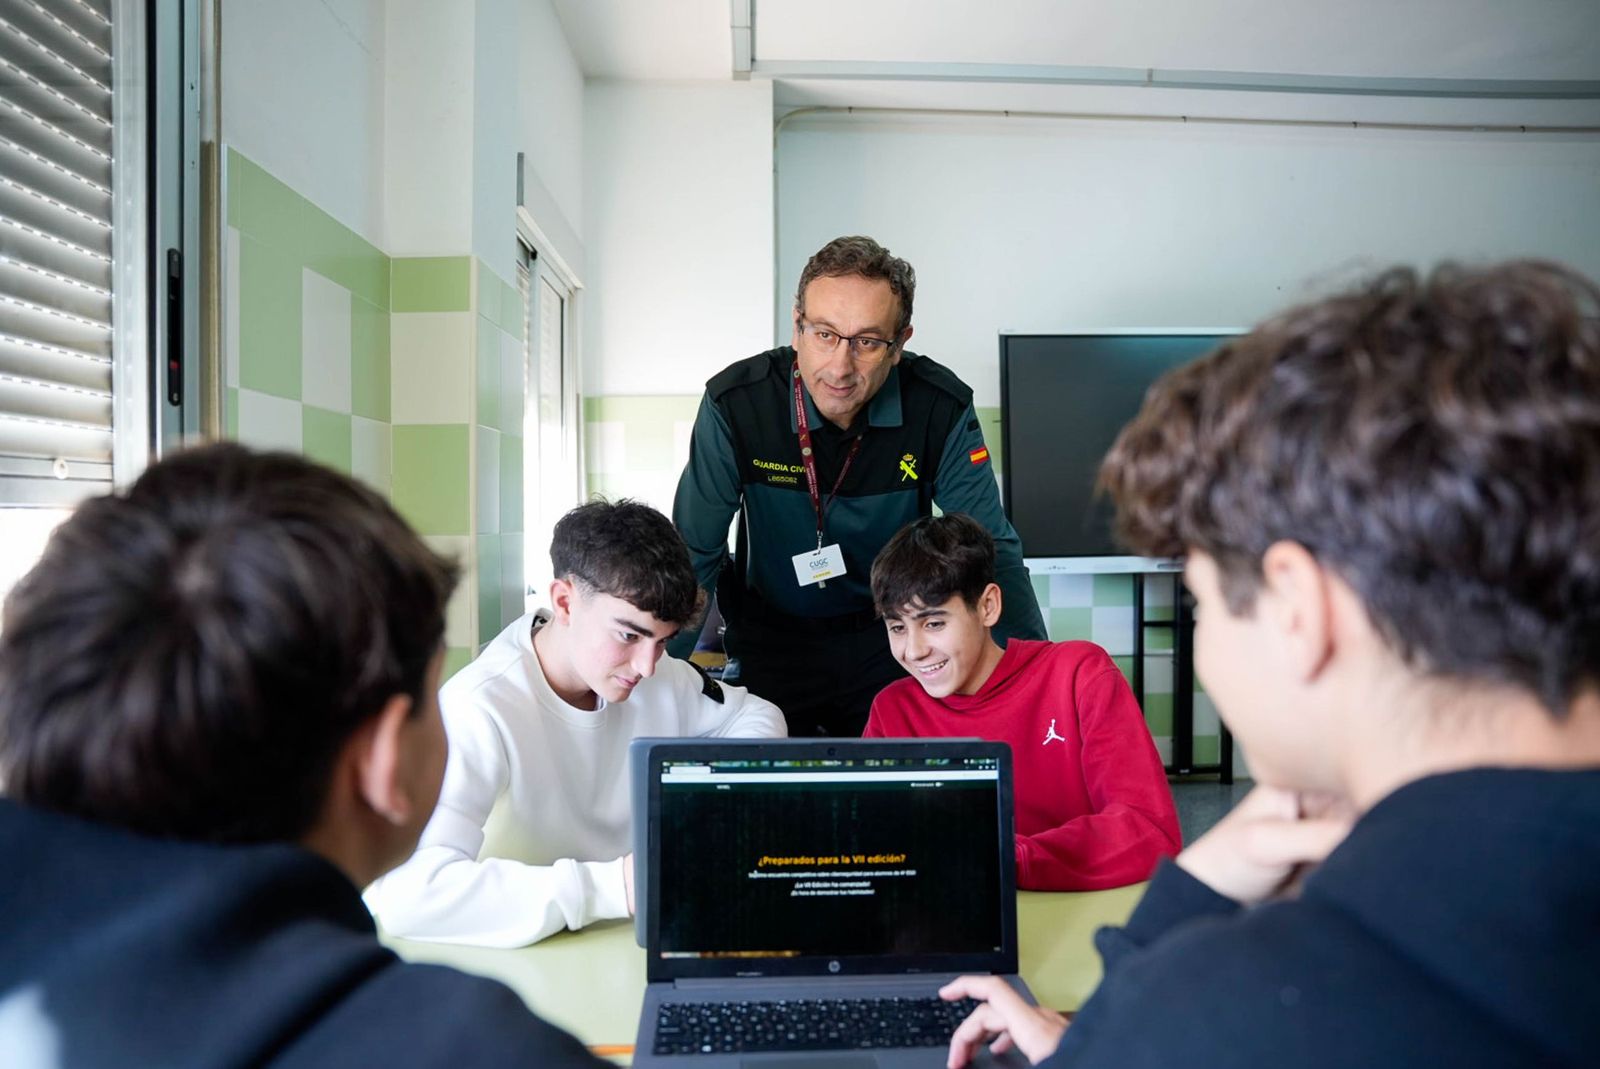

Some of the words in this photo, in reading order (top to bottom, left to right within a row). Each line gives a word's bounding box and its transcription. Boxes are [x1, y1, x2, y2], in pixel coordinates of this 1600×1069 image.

[753, 458, 788, 472] GUARDIA
[790, 465, 806, 473] CIVI
[758, 855, 816, 866] ¿Preparados
[817, 857, 839, 866] para
[840, 855, 850, 864] la
[852, 855, 865, 863] VII
[867, 854, 906, 864] edición?
